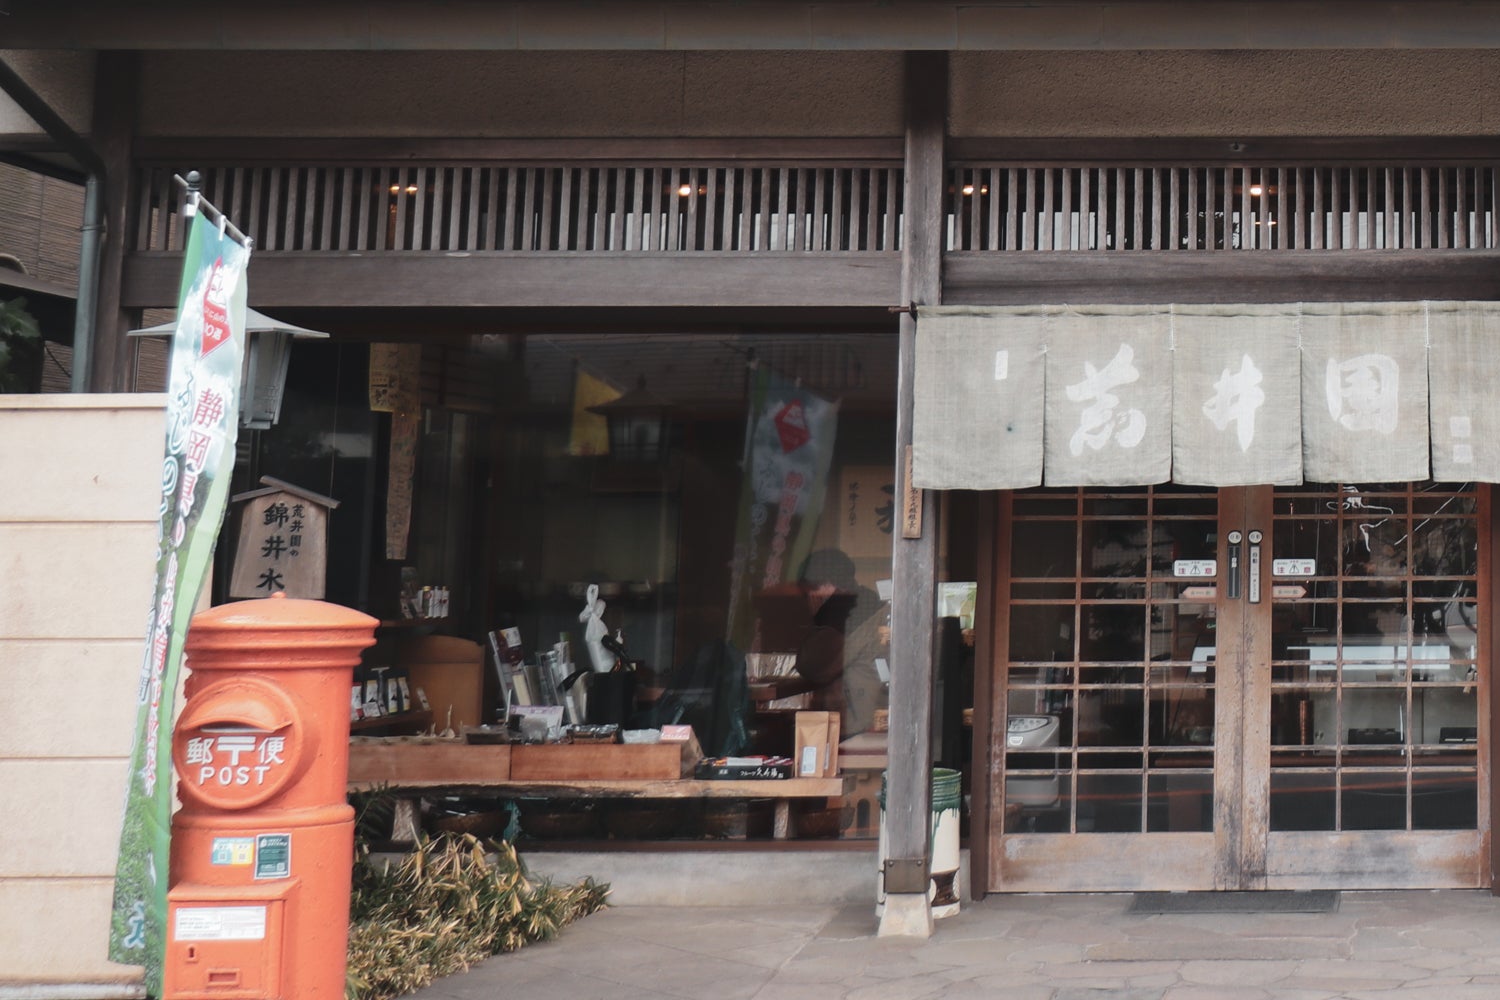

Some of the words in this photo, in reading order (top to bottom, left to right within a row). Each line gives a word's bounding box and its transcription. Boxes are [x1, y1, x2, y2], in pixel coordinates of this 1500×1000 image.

[1065, 343, 1401, 453] 荒井園
[200, 765, 271, 787] POST
